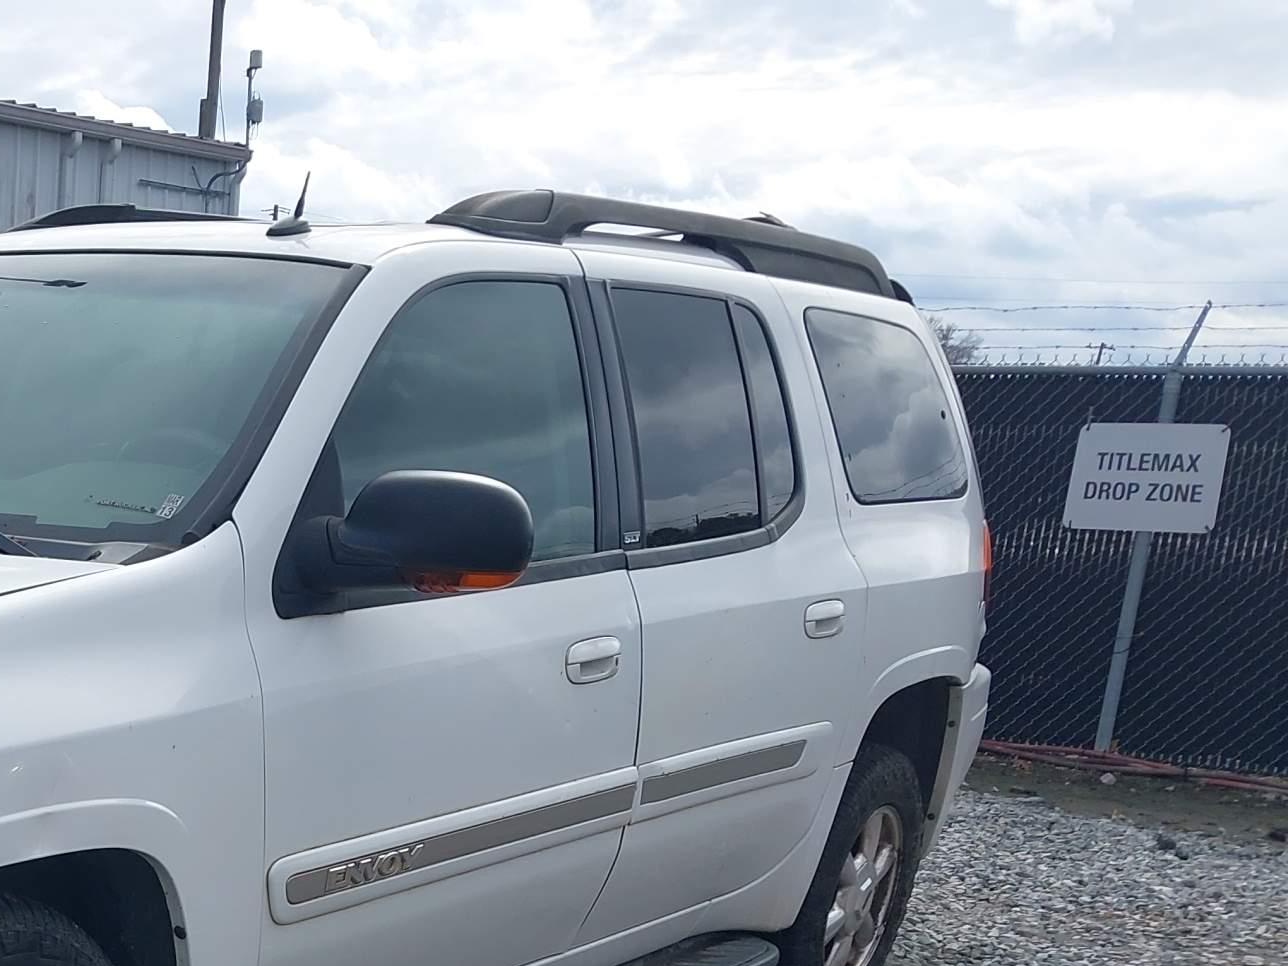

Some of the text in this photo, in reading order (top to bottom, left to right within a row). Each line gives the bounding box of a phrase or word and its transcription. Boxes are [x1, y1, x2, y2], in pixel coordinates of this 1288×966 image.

[1097, 452, 1201, 473] TITLEMAX
[1084, 481, 1203, 503] DROP ZONE
[326, 844, 424, 891] ENVOY
